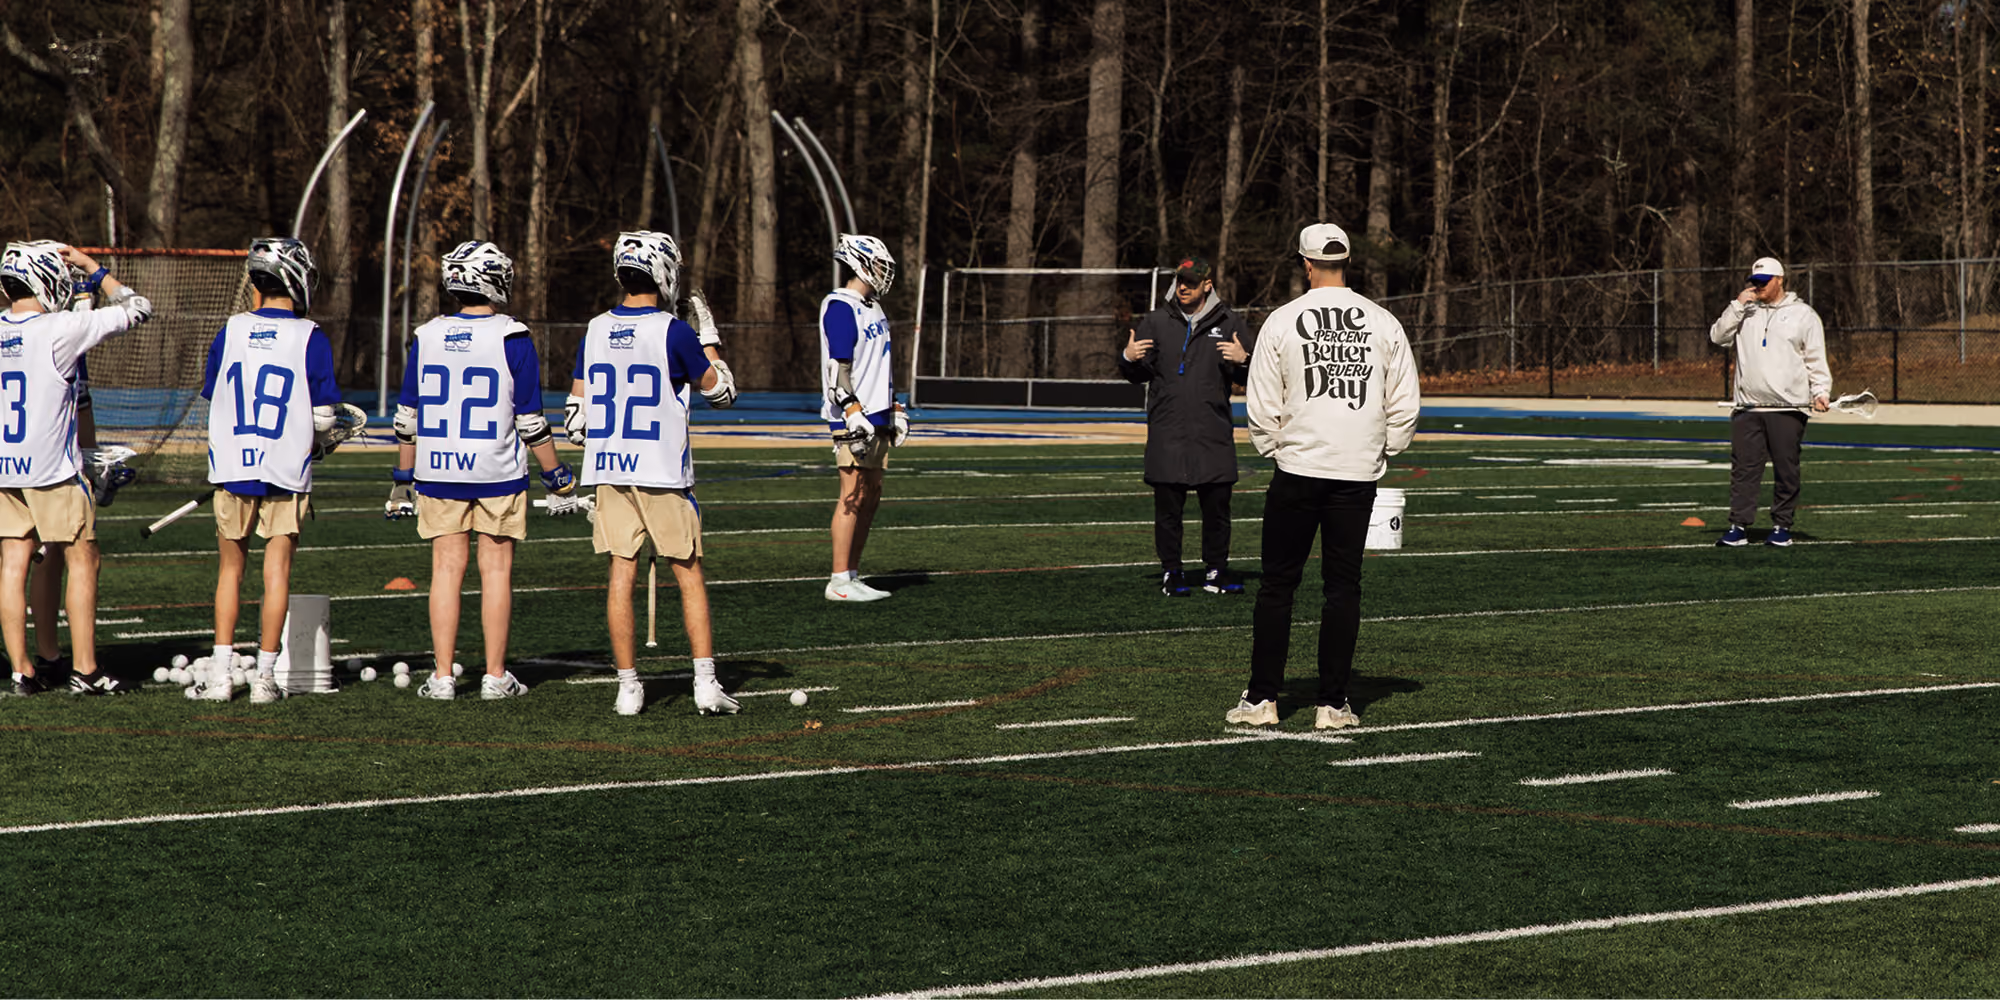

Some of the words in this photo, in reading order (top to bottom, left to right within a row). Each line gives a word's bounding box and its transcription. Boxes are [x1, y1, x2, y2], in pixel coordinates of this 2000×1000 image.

[1296, 307, 1366, 340] One
[1314, 329, 1372, 344] PERCENT
[1301, 341, 1372, 365] Better
[1326, 363, 1373, 382] EVERY
[1, 371, 27, 443] 3
[226, 361, 295, 440] 18
[417, 364, 500, 440] 22
[586, 363, 661, 441] 32
[1304, 364, 1367, 411] Day
